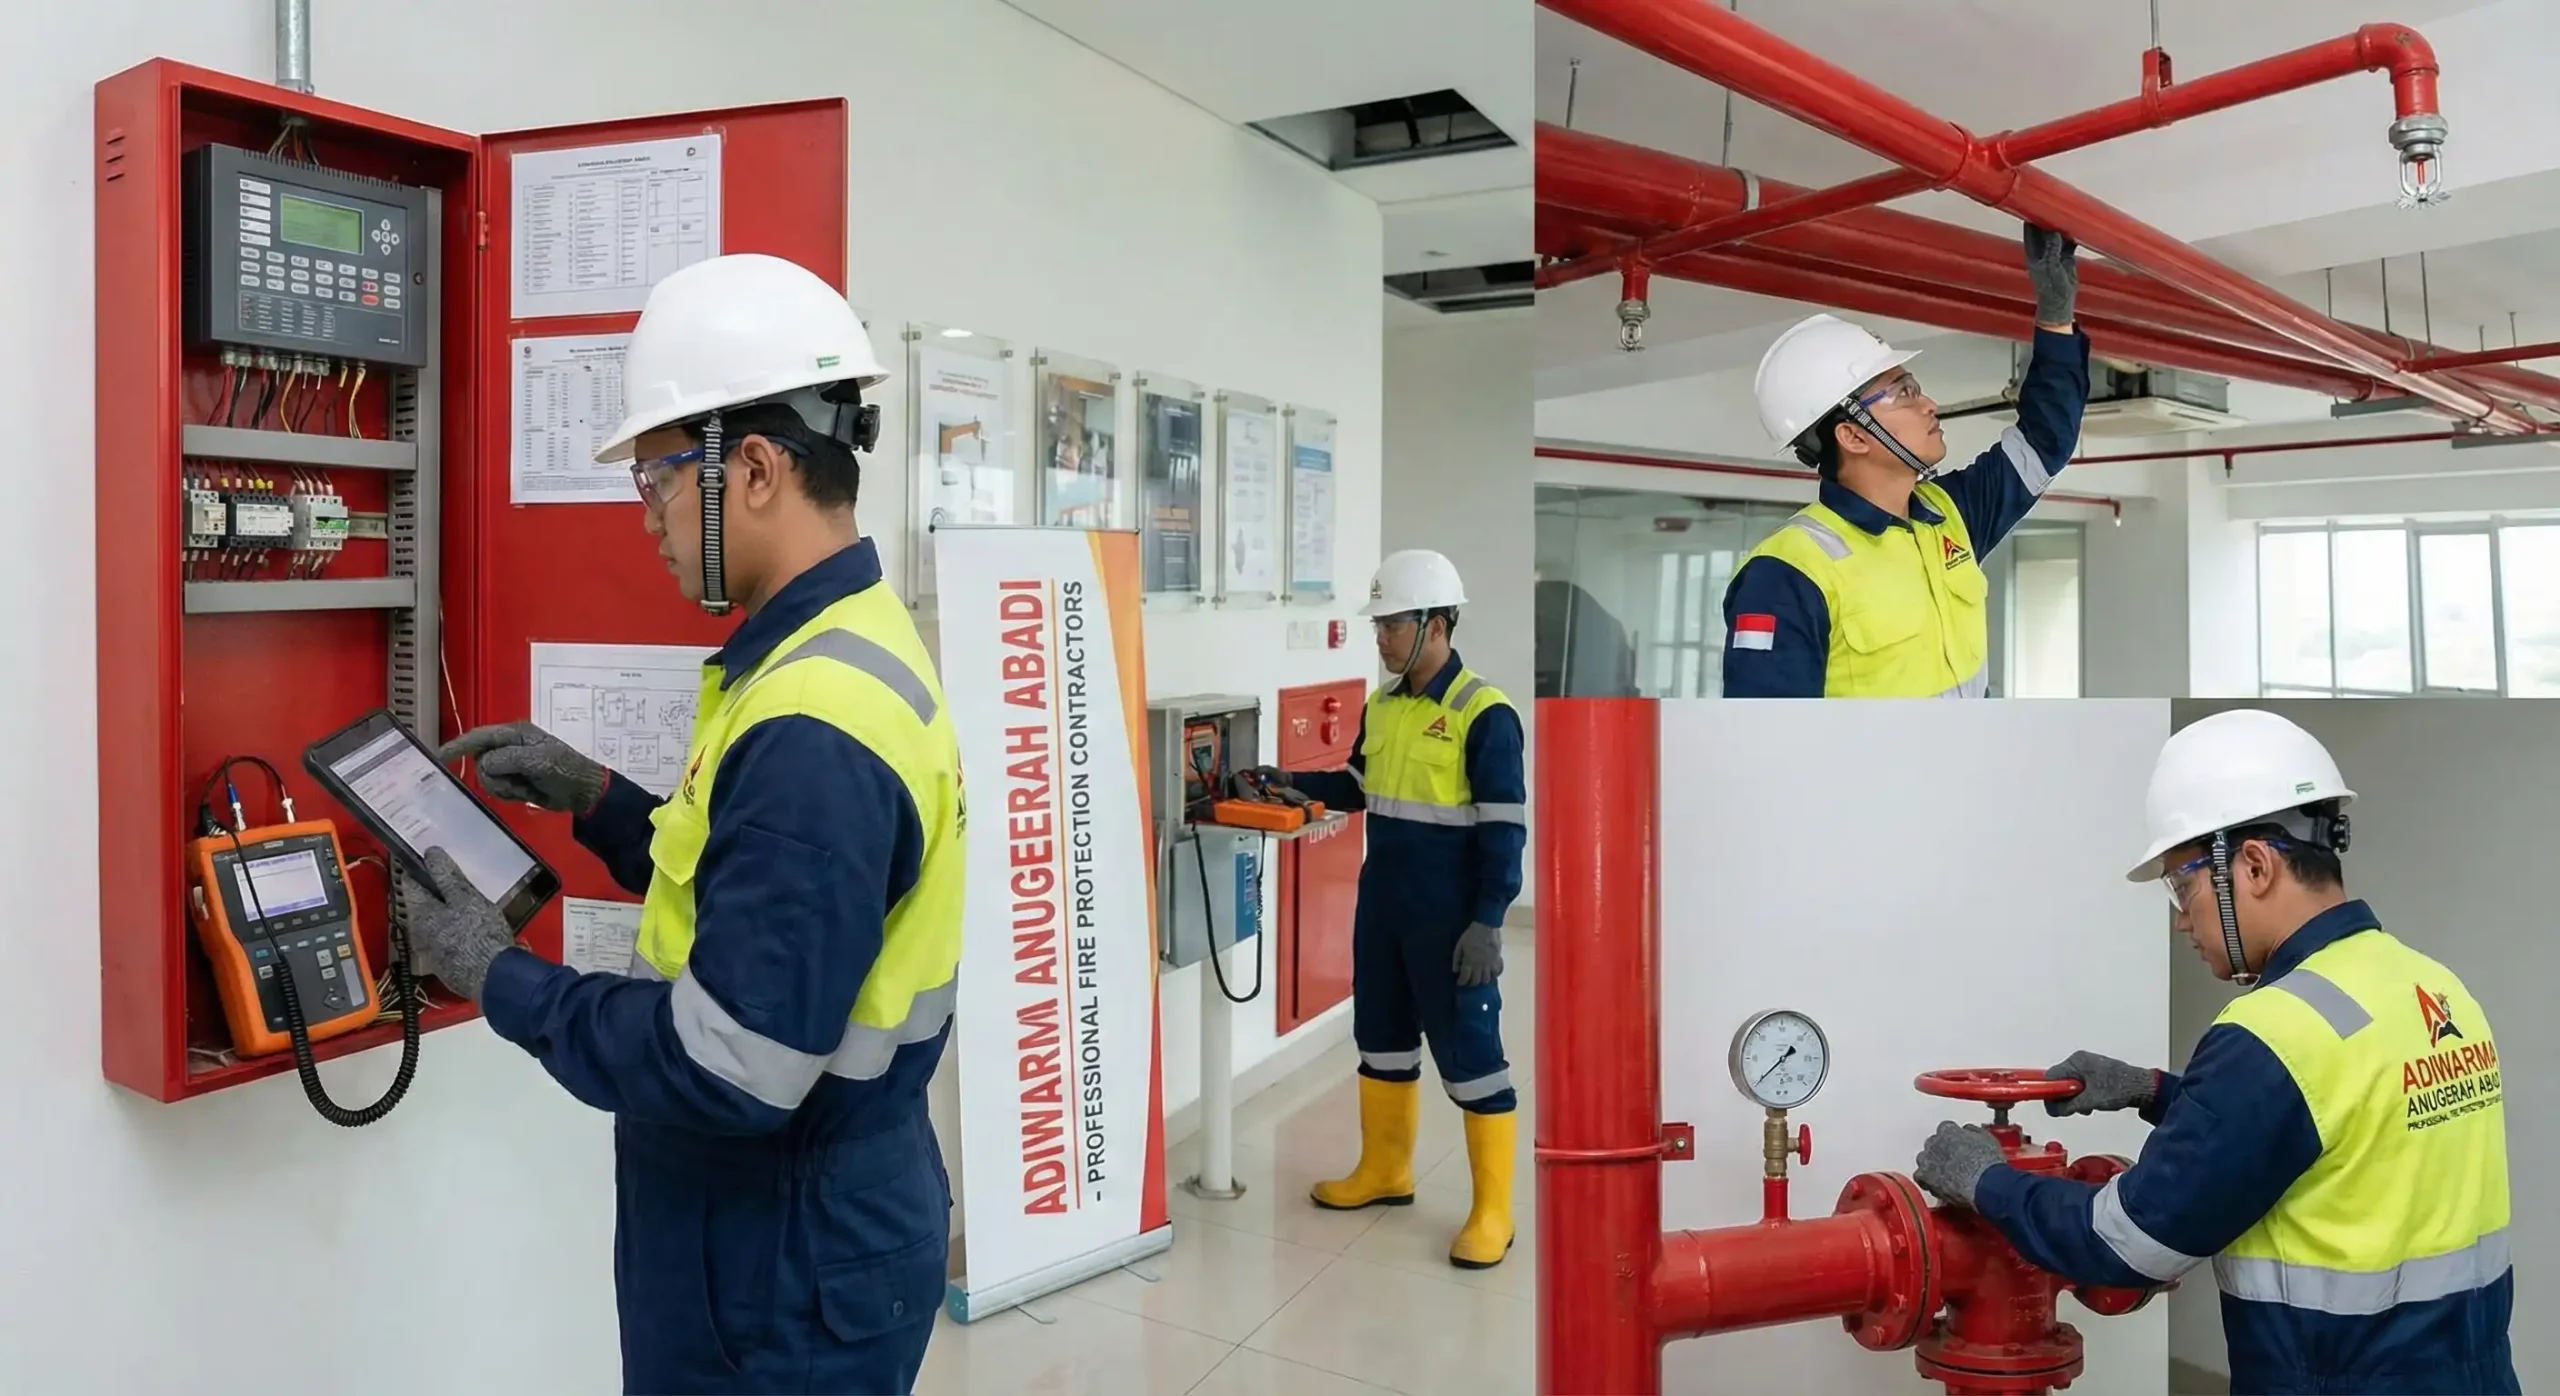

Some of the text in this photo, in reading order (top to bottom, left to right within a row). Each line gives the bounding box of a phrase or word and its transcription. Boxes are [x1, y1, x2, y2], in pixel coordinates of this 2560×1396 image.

[999, 580, 1047, 710] ABADI
[1063, 581, 1089, 766] CONTRACTORS
[1005, 725, 1058, 985] ANUGEERAH
[1071, 773, 1095, 928] PROTECTION
[1077, 936, 1098, 989] FIRE
[1080, 995, 1106, 1184] PROFESSIONAL
[2403, 1040, 2499, 1095] ADIWARMA
[2407, 1079, 2476, 1117] ANUGERAH
